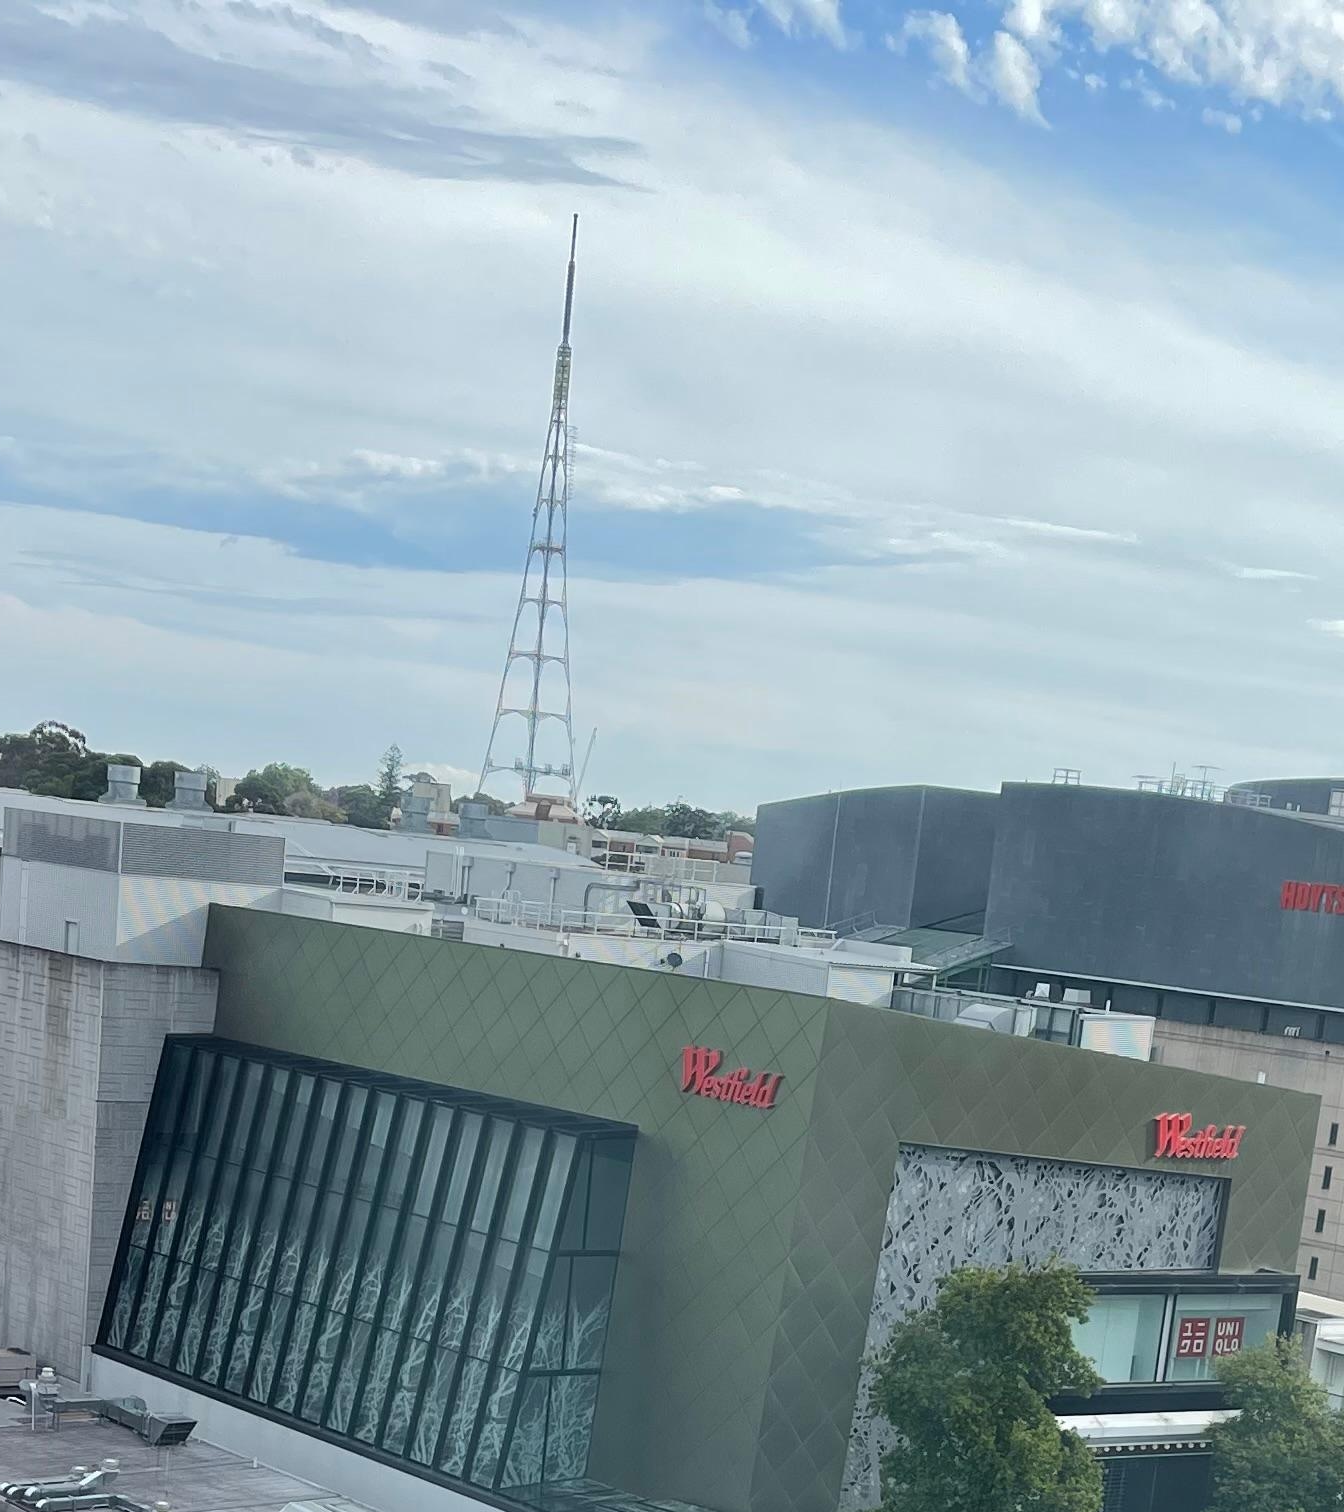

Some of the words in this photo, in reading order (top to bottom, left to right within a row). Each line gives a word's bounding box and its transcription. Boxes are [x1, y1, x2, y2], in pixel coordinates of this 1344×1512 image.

[680, 1044, 785, 1110] Westfield
[1154, 1111, 1247, 1159] Westfield
[1217, 1321, 1240, 1336] UNI
[1215, 1338, 1239, 1356] QLO
